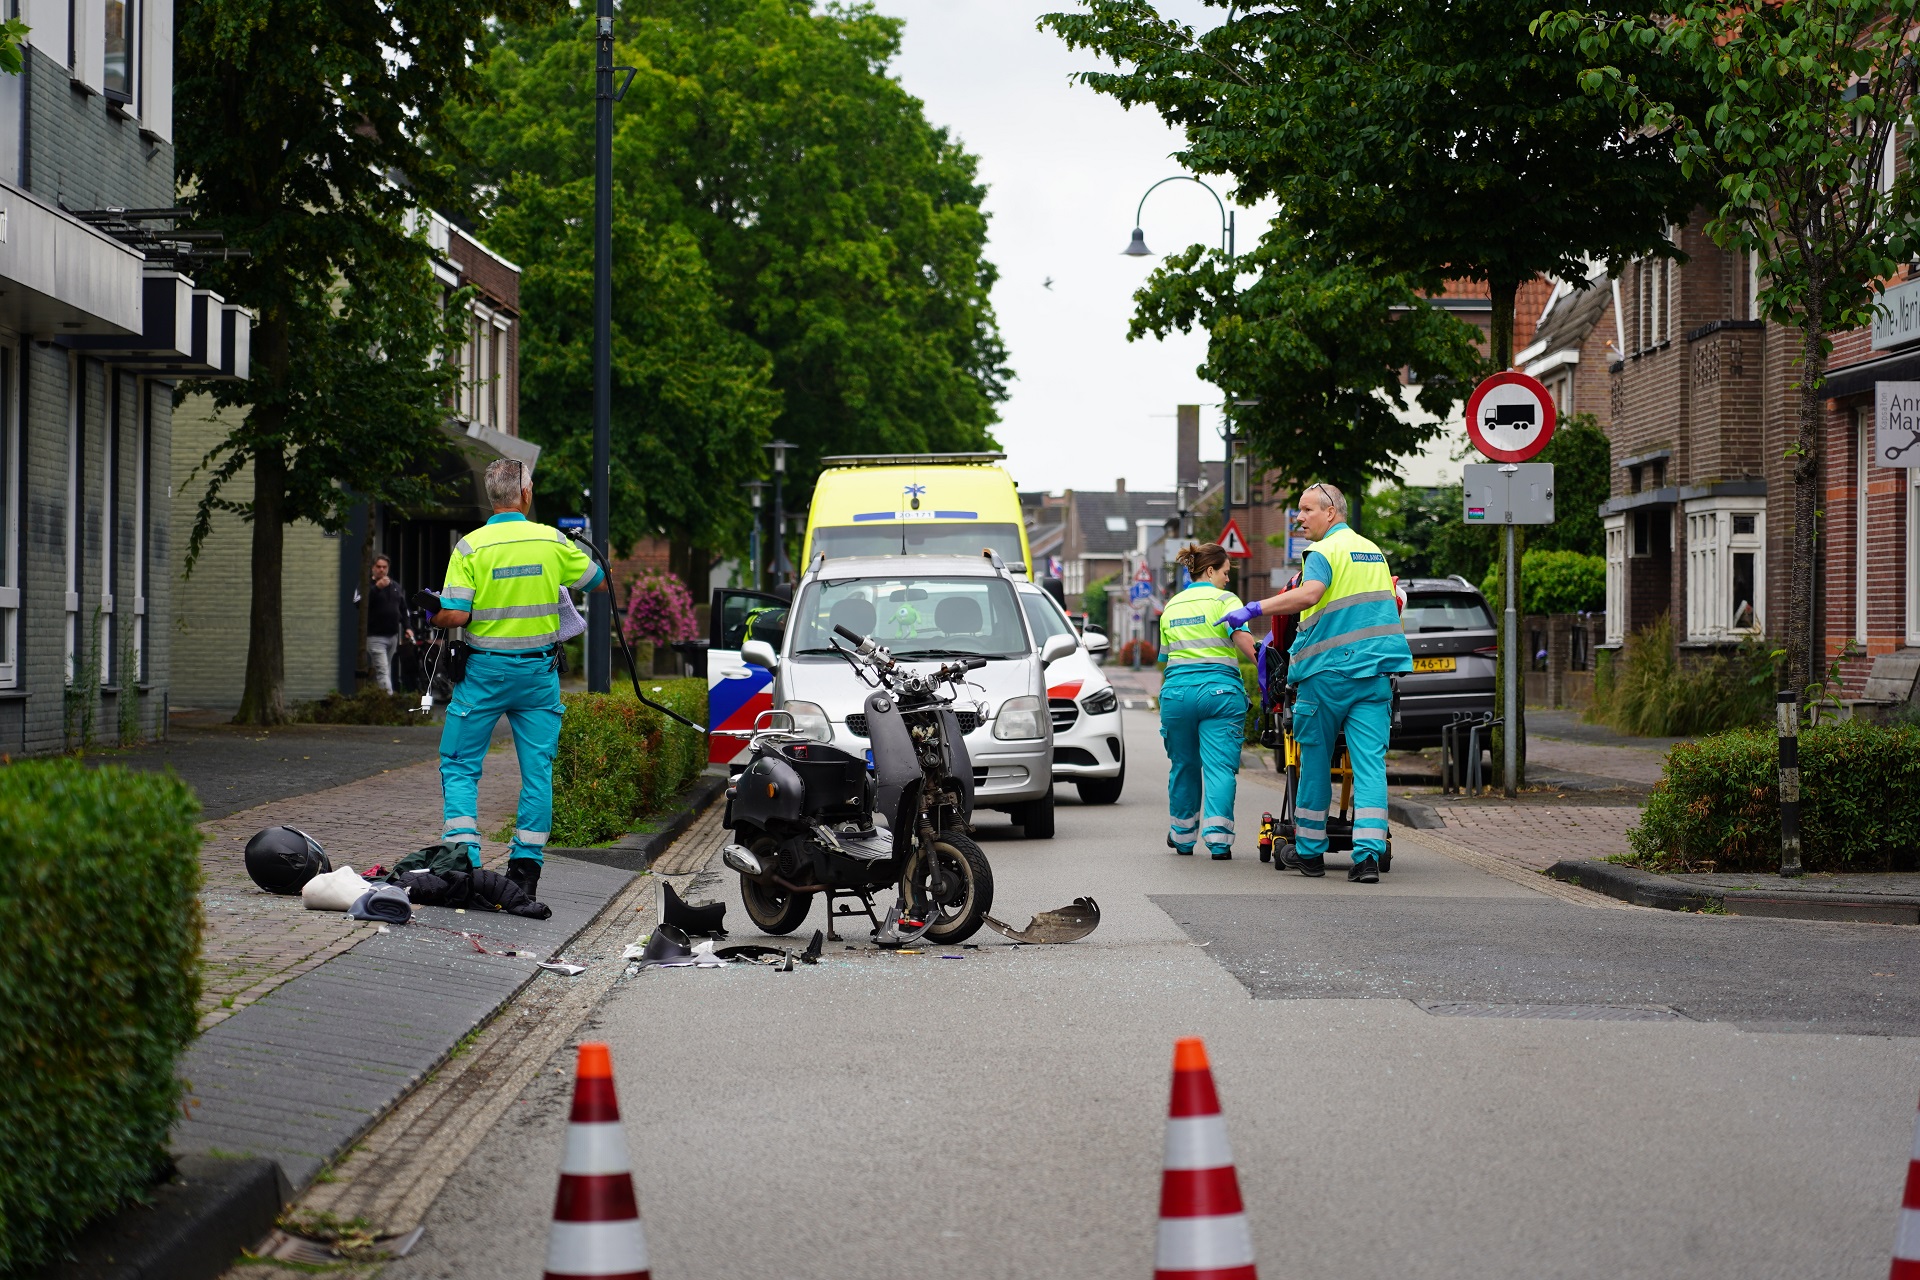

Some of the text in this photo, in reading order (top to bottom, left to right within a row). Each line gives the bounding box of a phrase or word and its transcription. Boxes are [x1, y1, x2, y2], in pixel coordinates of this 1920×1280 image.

[1899, 290, 1920, 333] Mari
[494, 566, 541, 578] AMBULANCE
[1170, 616, 1205, 627] AMBULANCE
[1413, 658, 1450, 669] 746-TJ
